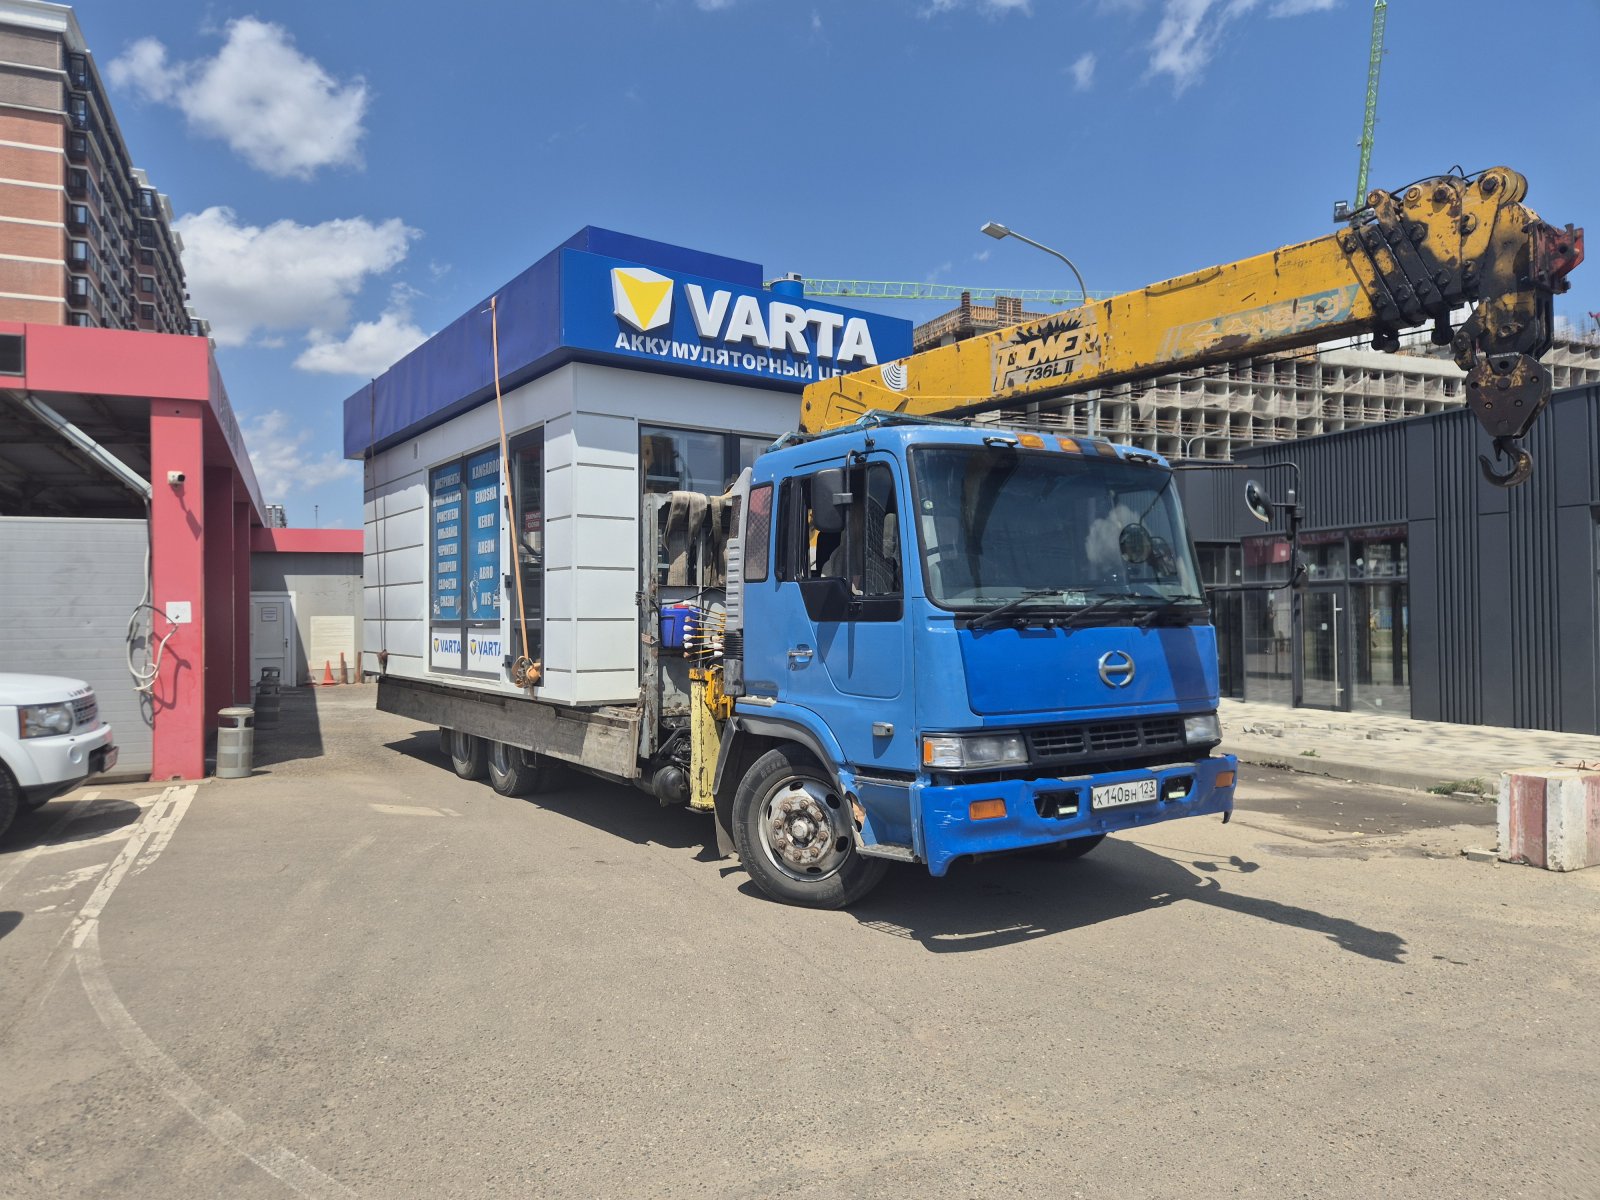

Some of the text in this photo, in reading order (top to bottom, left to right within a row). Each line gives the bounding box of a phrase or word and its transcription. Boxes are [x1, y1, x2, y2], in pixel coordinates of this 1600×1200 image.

[684, 283, 878, 365] VARTA
[615, 332, 812, 379] АККУМУЛЯТОРНЫЙ
[994, 322, 1100, 392] POWER
[478, 513, 494, 528] KERRY
[478, 539, 495, 554] AREON
[479, 566, 493, 579] ABRO
[481, 592, 491, 606] AVS
[440, 640, 461, 654] VARTA
[1140, 781, 1154, 795] 123
